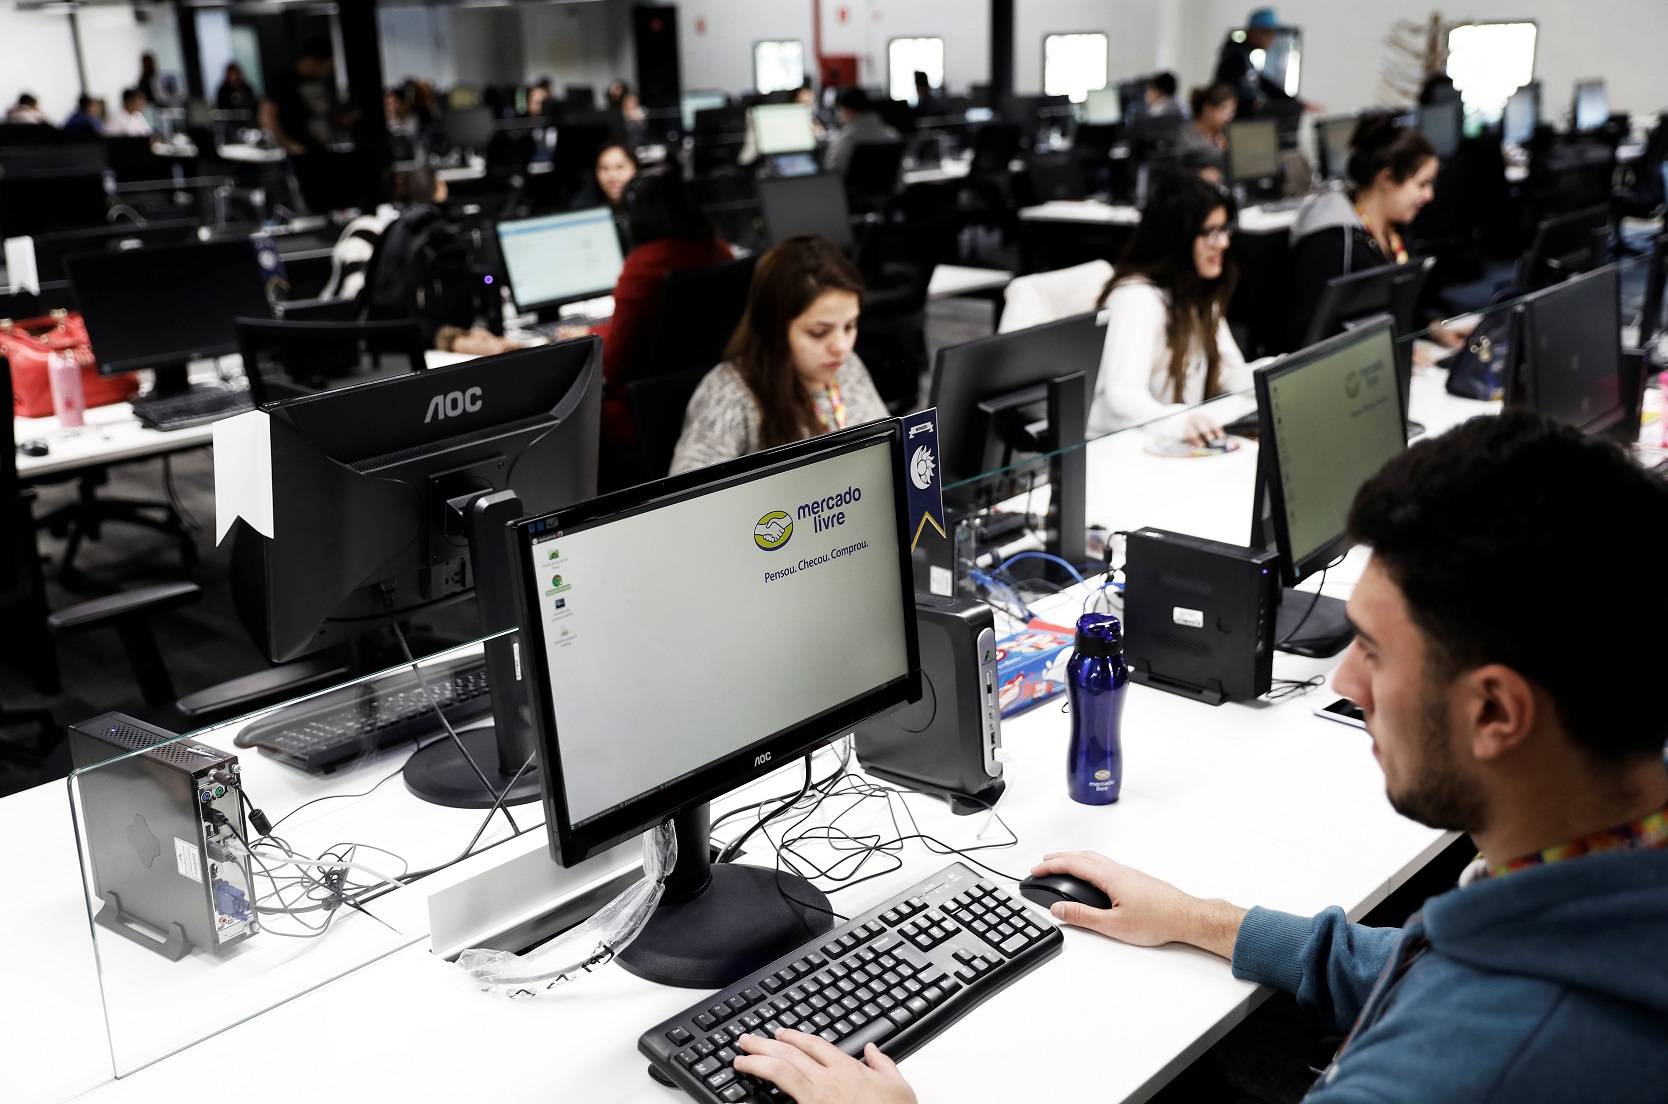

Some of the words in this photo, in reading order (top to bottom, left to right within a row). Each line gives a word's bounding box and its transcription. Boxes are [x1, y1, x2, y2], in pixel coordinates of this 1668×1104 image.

[424, 386, 482, 423] AOC
[797, 486, 862, 520] mercado
[813, 511, 846, 533] livre
[764, 565, 797, 583] Pensou.
[798, 554, 830, 571] Checou.
[830, 540, 869, 559] Comprou.
[754, 751, 771, 767] AOC
